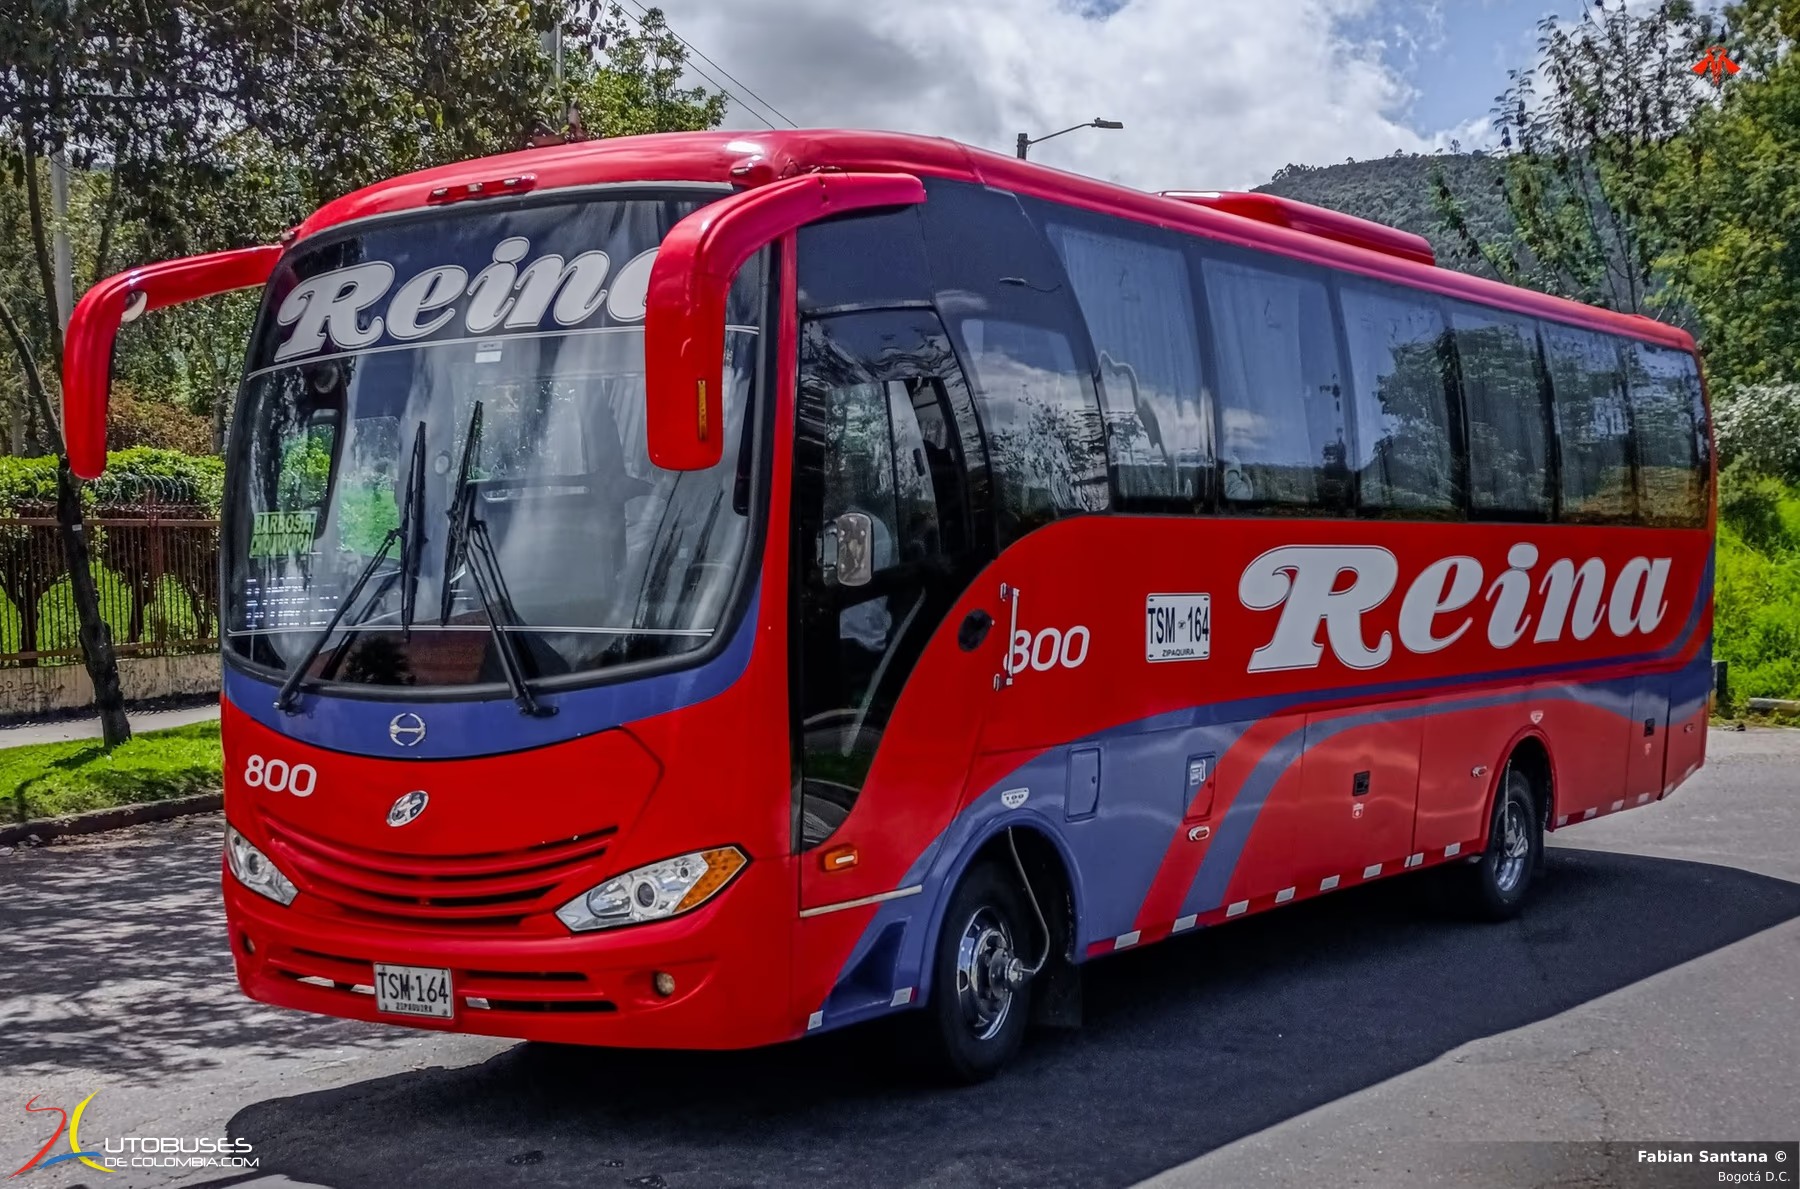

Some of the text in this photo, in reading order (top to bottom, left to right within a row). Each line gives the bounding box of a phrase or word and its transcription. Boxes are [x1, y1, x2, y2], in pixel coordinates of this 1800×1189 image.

[254, 513, 312, 534] BARBOSA
[1238, 541, 1672, 674] Reina
[1003, 625, 1091, 675] 800
[1162, 648, 1195, 657] ZIPAQUIRA
[244, 754, 317, 797] 800
[396, 1002, 433, 1013] ZIPAQUIRA
